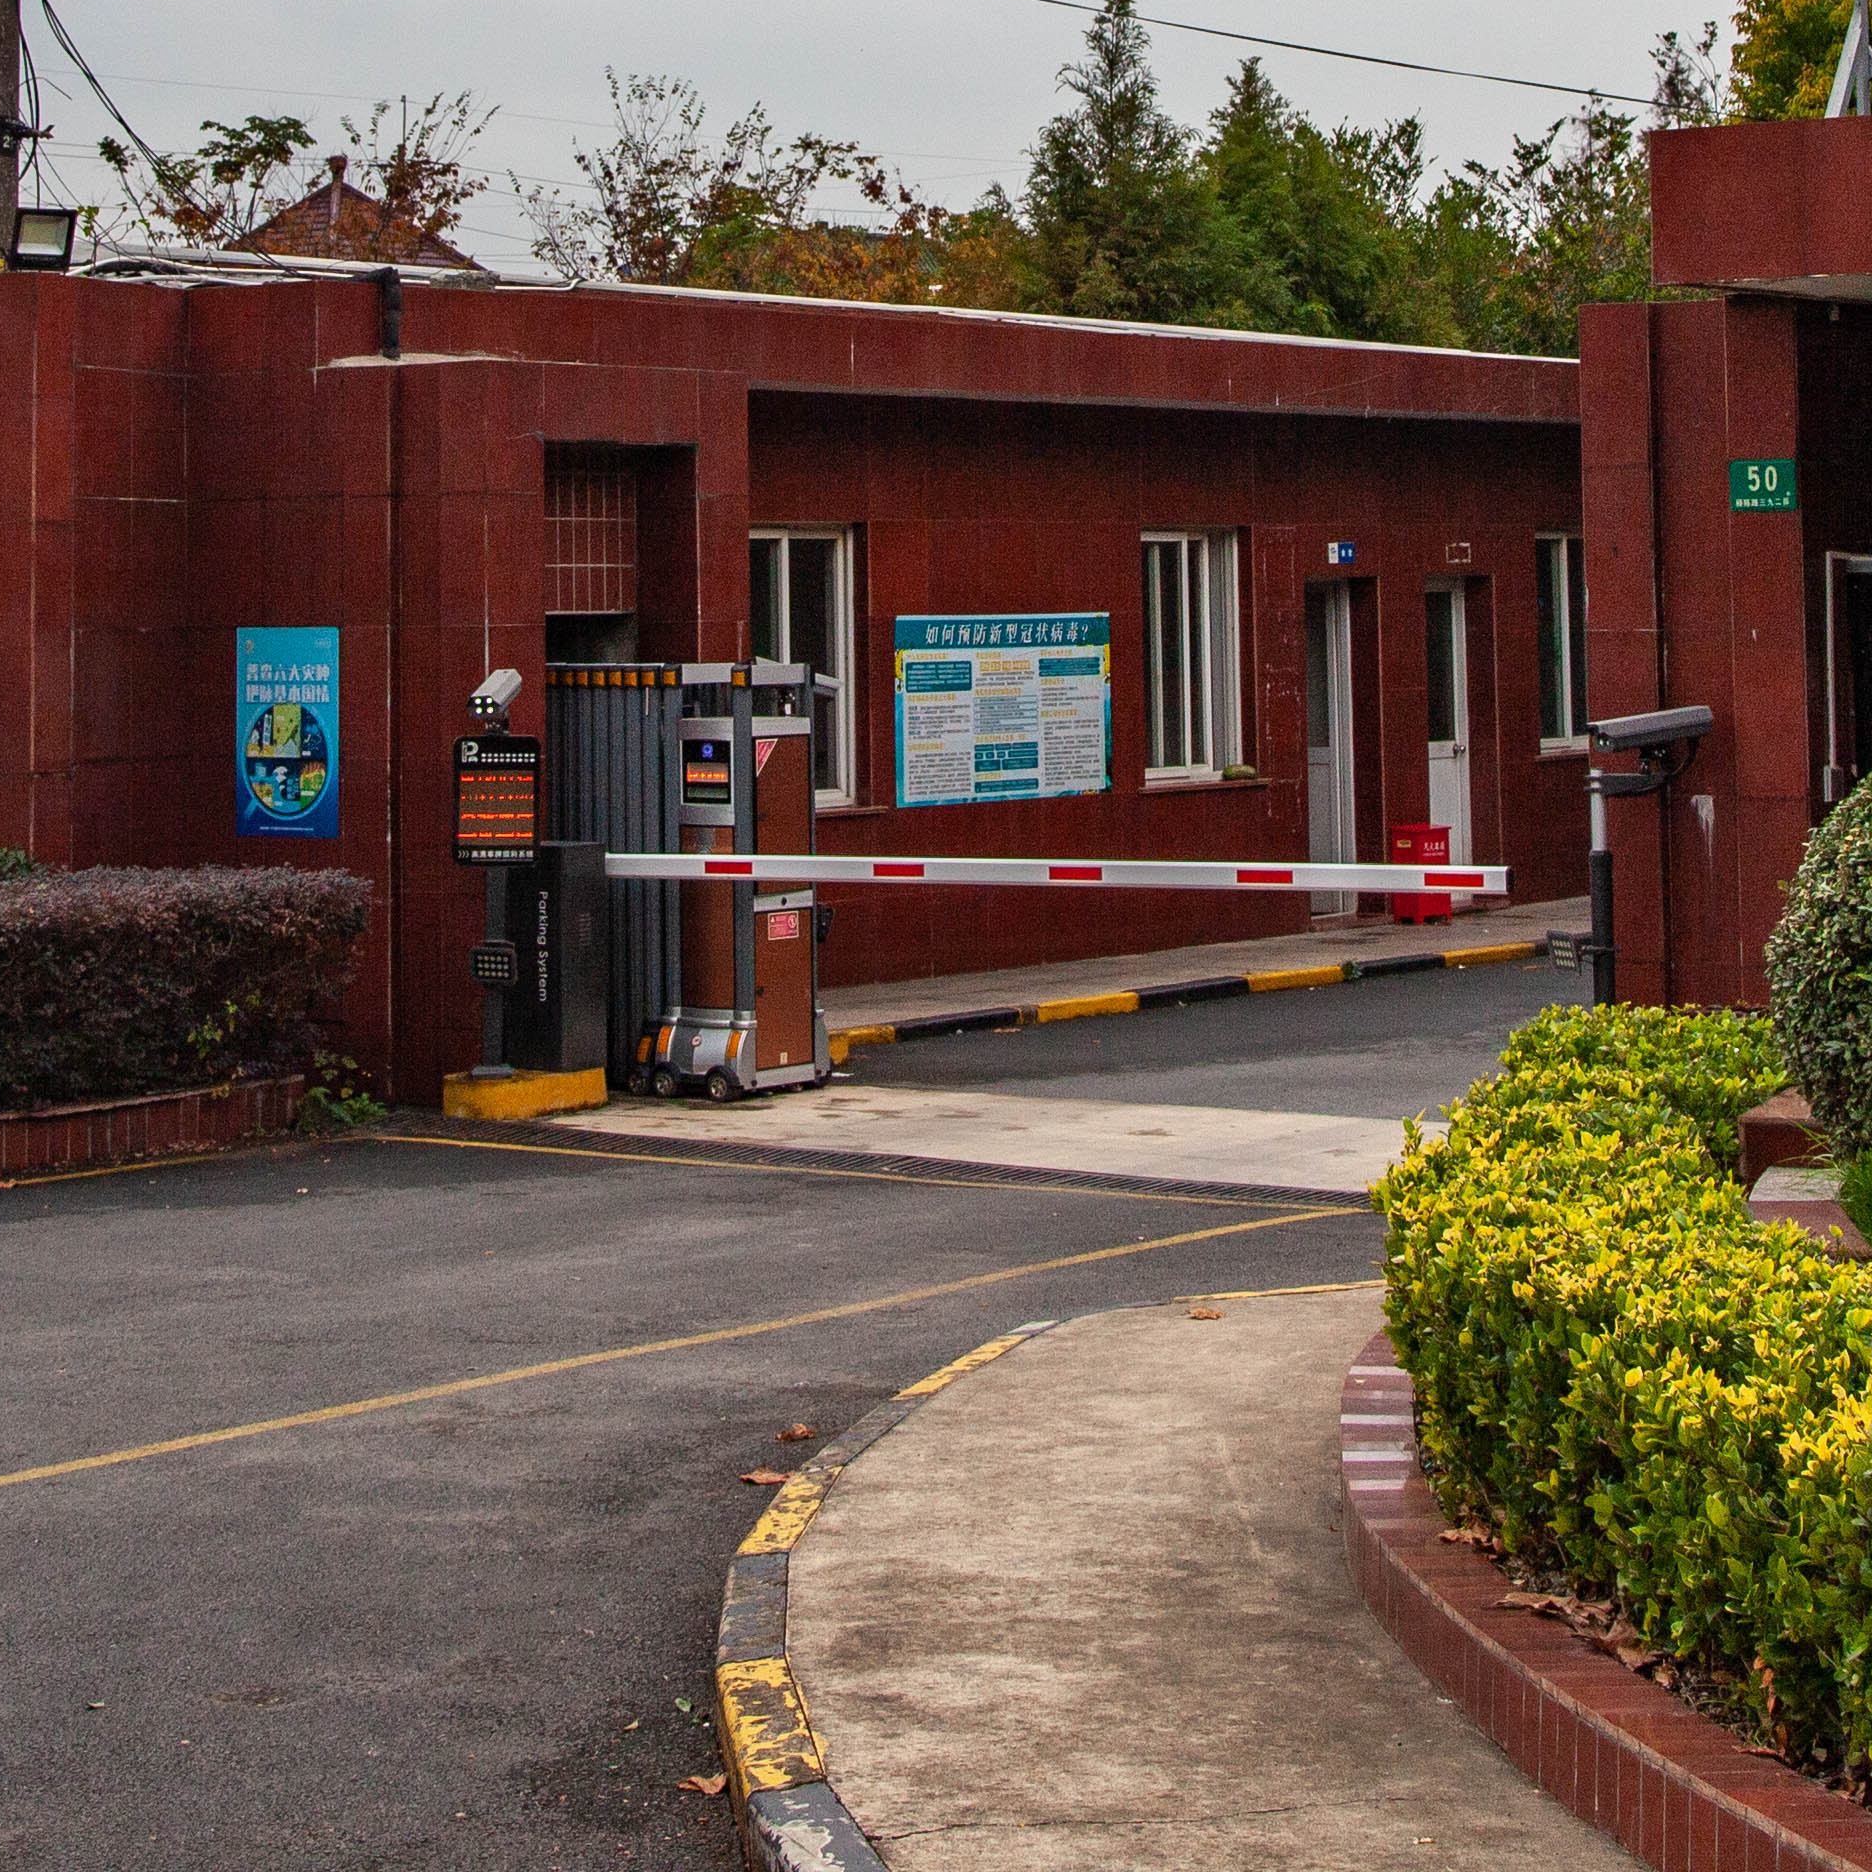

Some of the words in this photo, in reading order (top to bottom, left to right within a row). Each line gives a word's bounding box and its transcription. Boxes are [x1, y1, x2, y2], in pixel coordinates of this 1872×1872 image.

[1747, 465, 1778, 492] 50
[536, 891, 549, 945] Parking
[537, 950, 549, 1002] System
